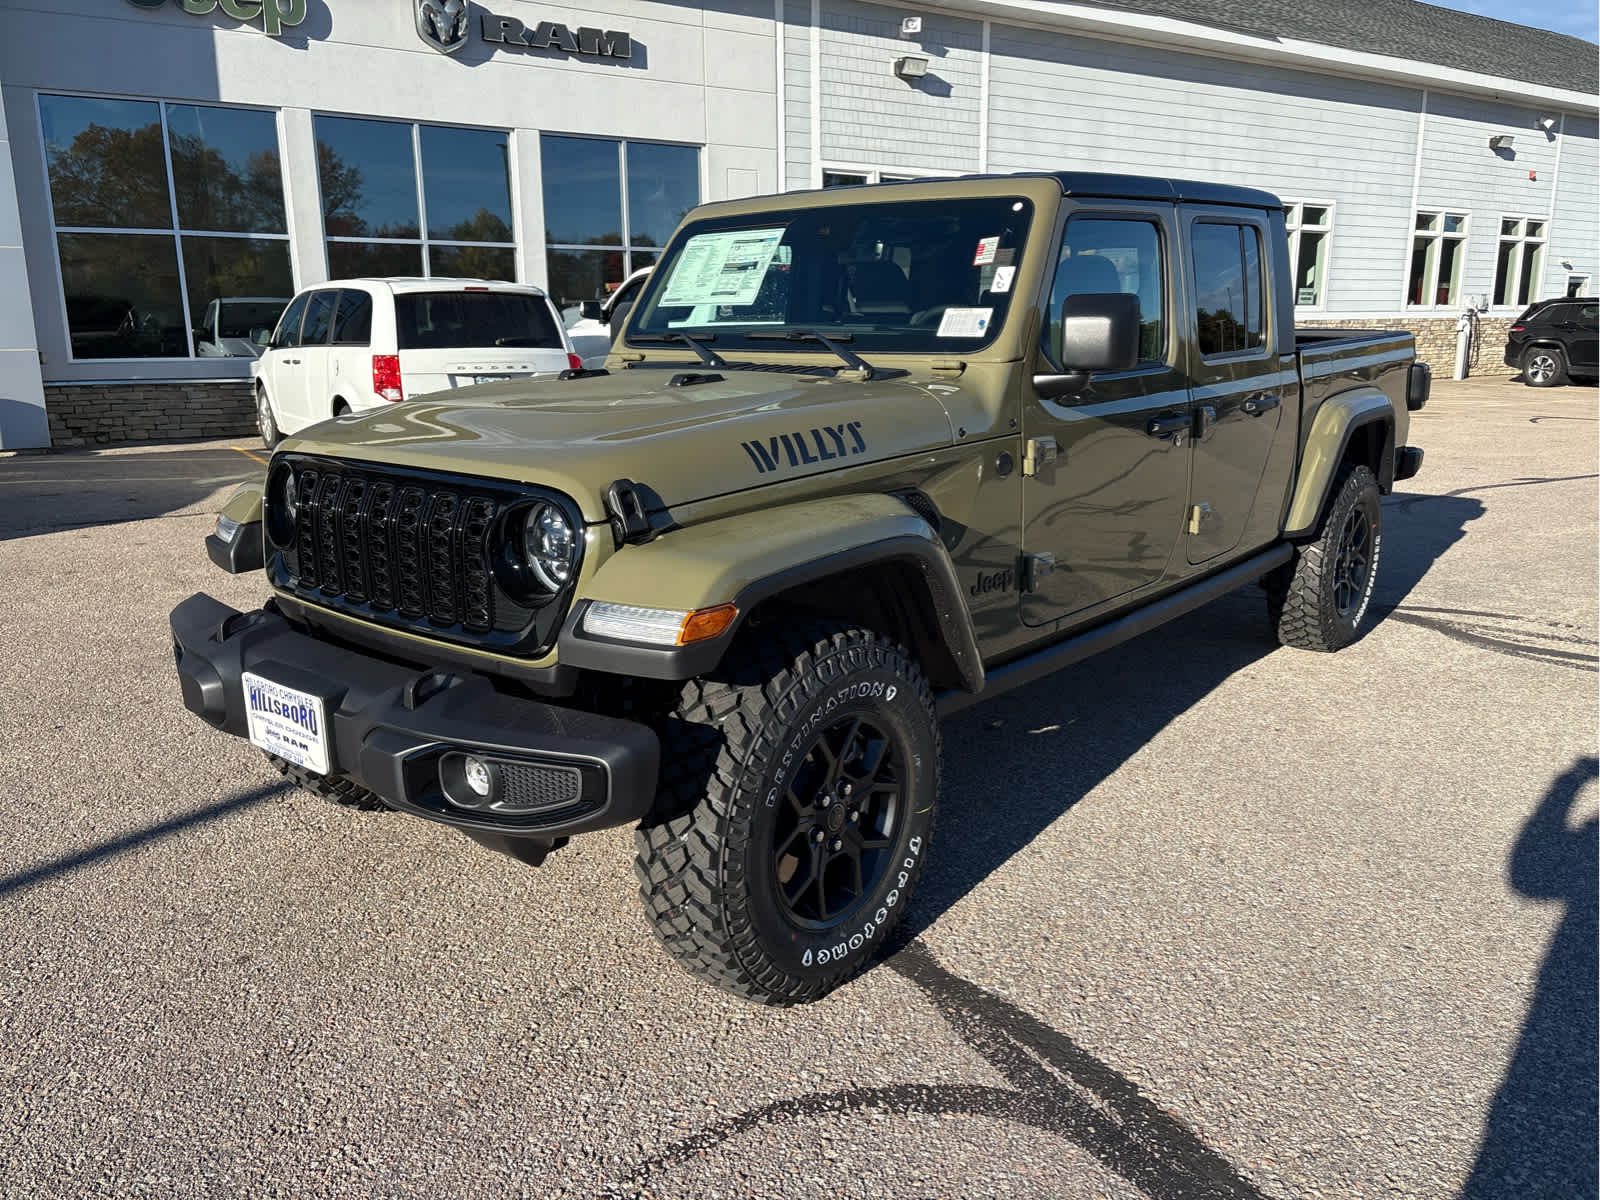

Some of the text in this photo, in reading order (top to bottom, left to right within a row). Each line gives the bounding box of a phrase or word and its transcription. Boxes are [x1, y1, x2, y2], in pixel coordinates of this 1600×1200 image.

[480, 14, 632, 59] RAM
[740, 421, 867, 474] WILLYS
[970, 568, 1013, 598] Jeep
[249, 685, 319, 737] HILLSBORO
[765, 681, 885, 807] DESTINATION
